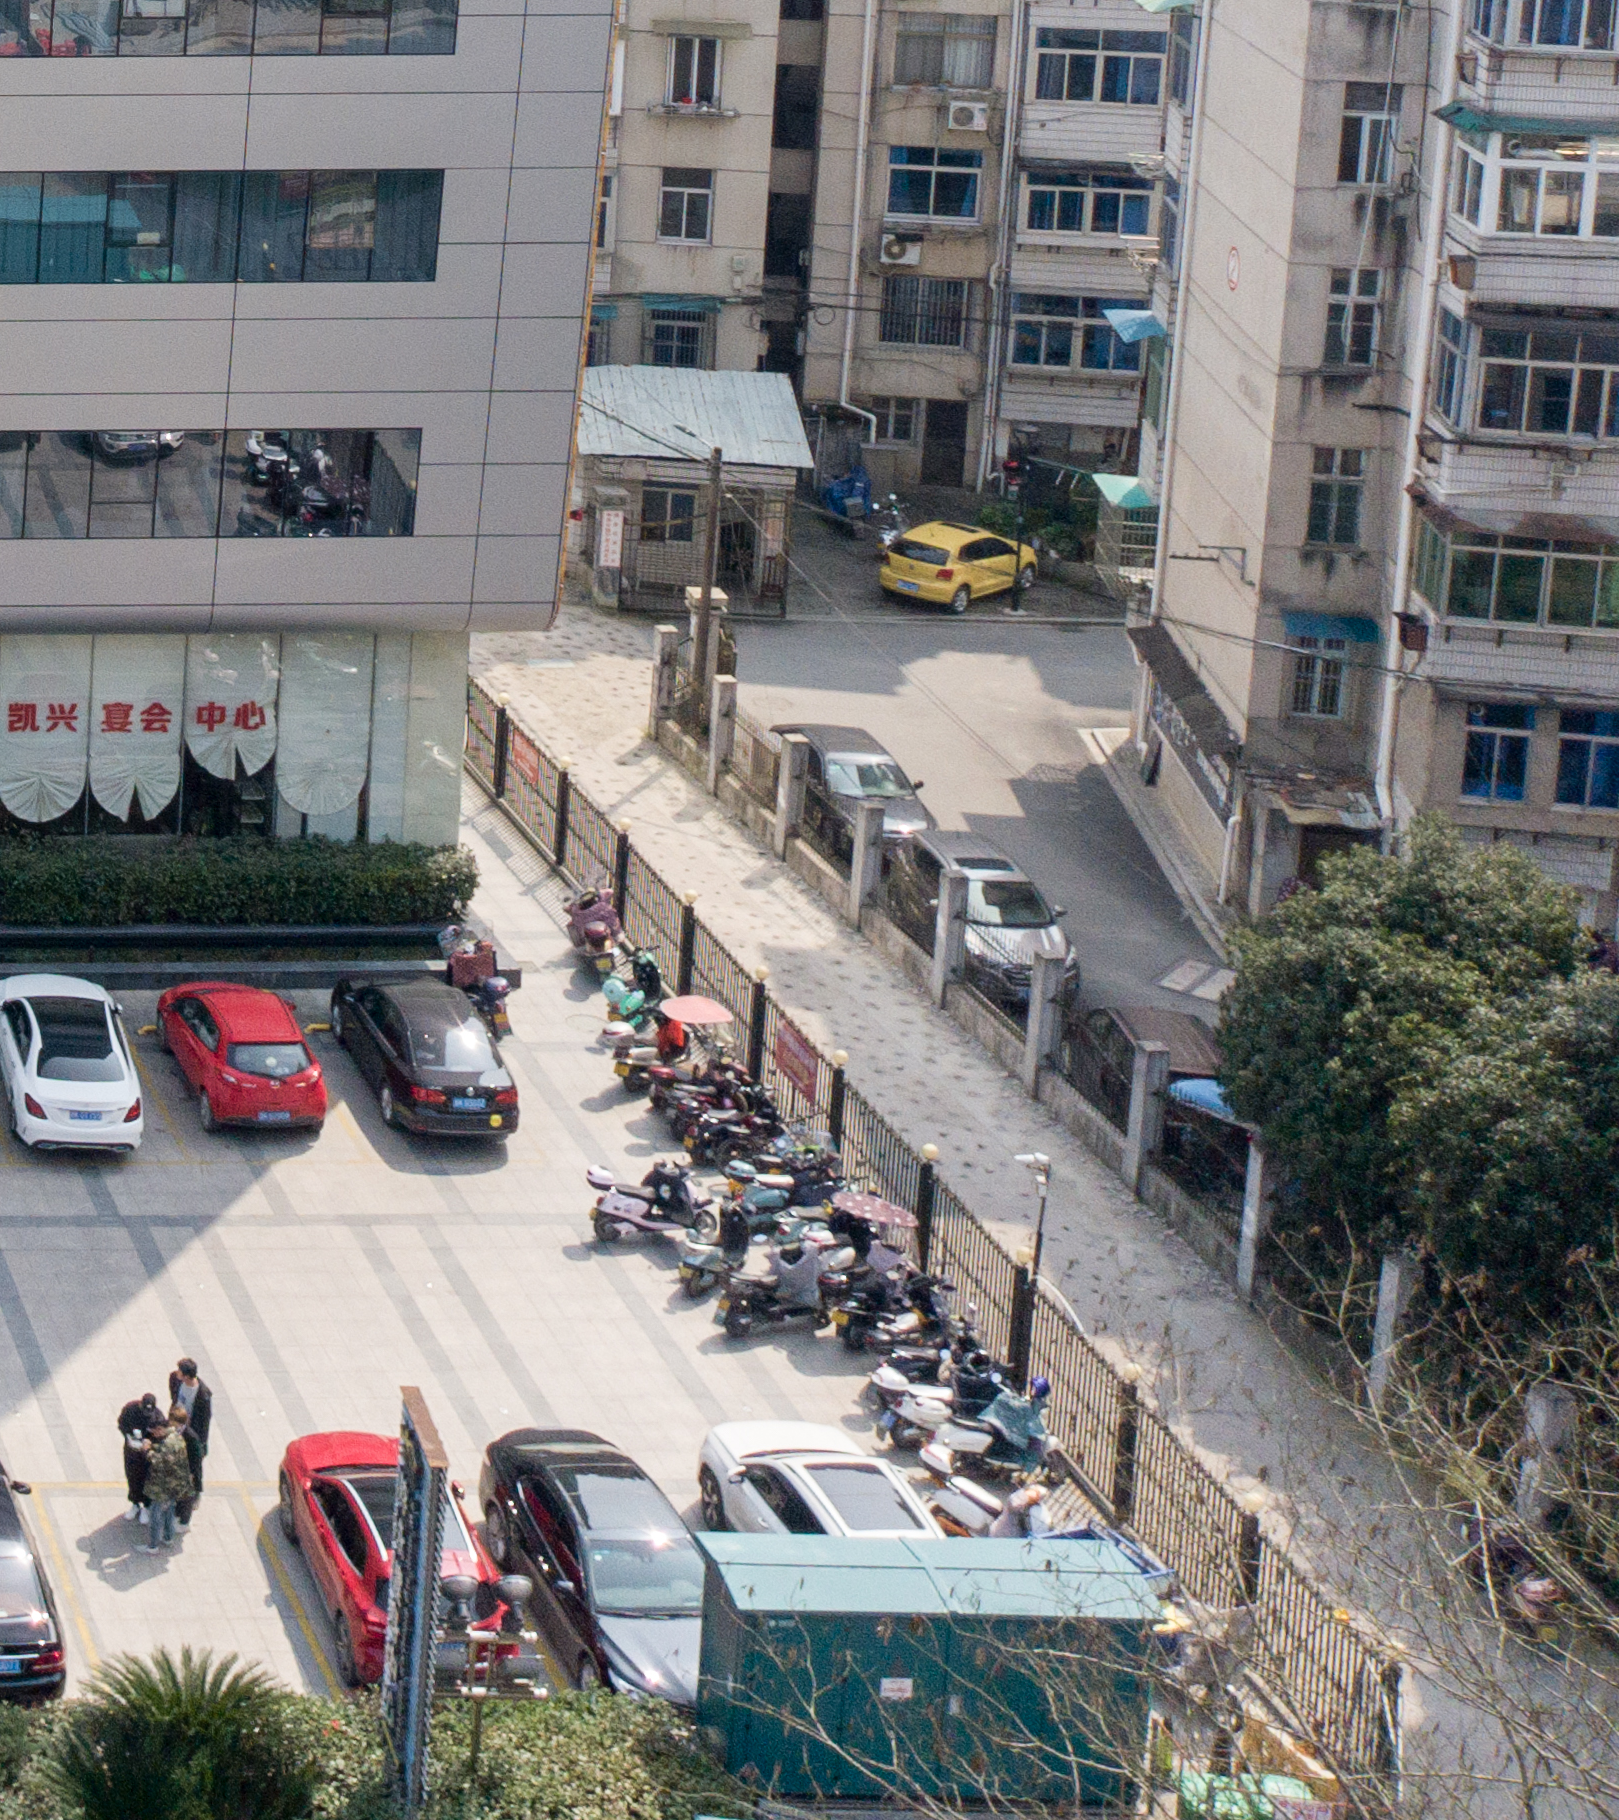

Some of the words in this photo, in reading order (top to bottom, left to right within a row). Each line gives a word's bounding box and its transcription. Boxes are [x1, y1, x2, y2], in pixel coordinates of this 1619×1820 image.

[7, 701, 267, 733] 凯兴宴会中心
